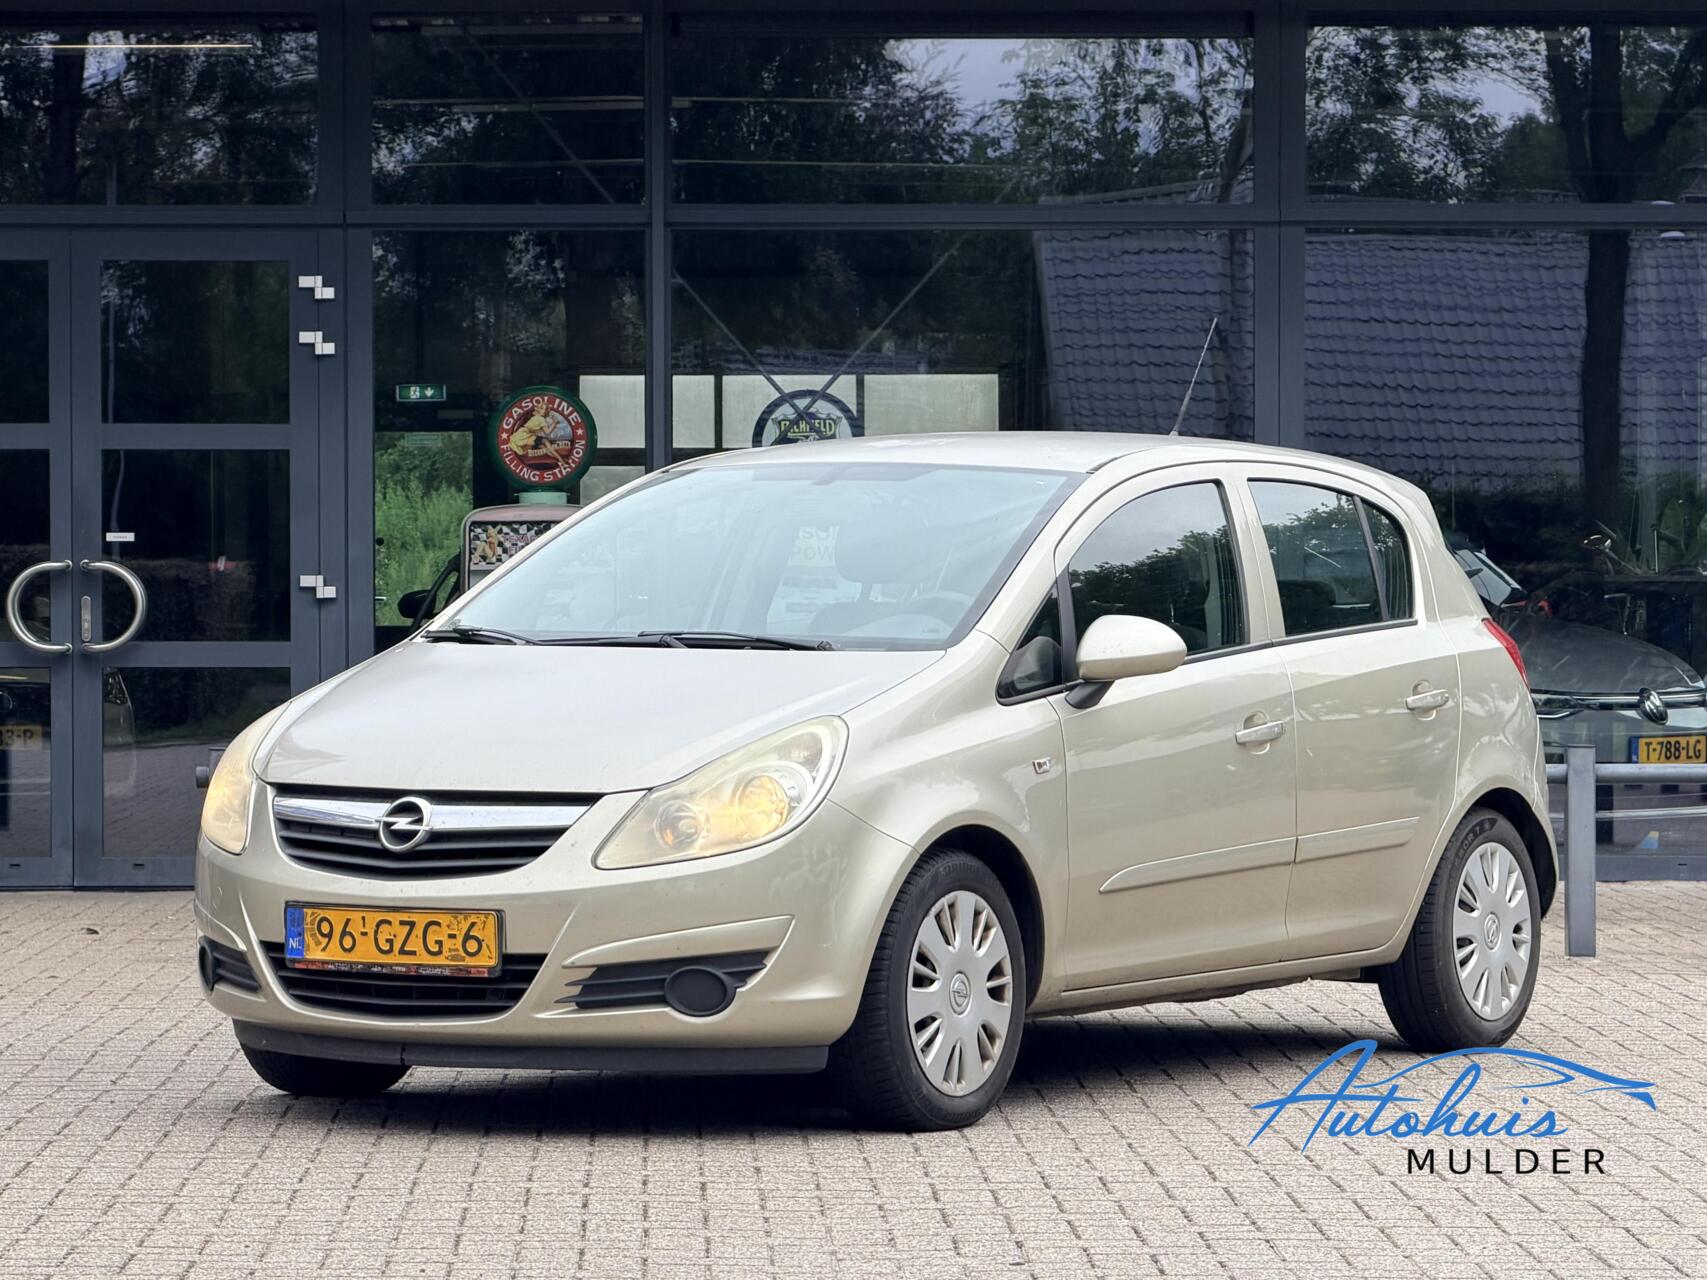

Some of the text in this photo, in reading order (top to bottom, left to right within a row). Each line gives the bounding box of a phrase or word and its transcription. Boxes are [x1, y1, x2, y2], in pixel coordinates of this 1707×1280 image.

[502, 396, 582, 430] GASOLINE
[501, 440, 585, 481] FILLING STATION
[1644, 740, 1702, 761] T-788-LG
[315, 915, 484, 958] 96-GZG-6
